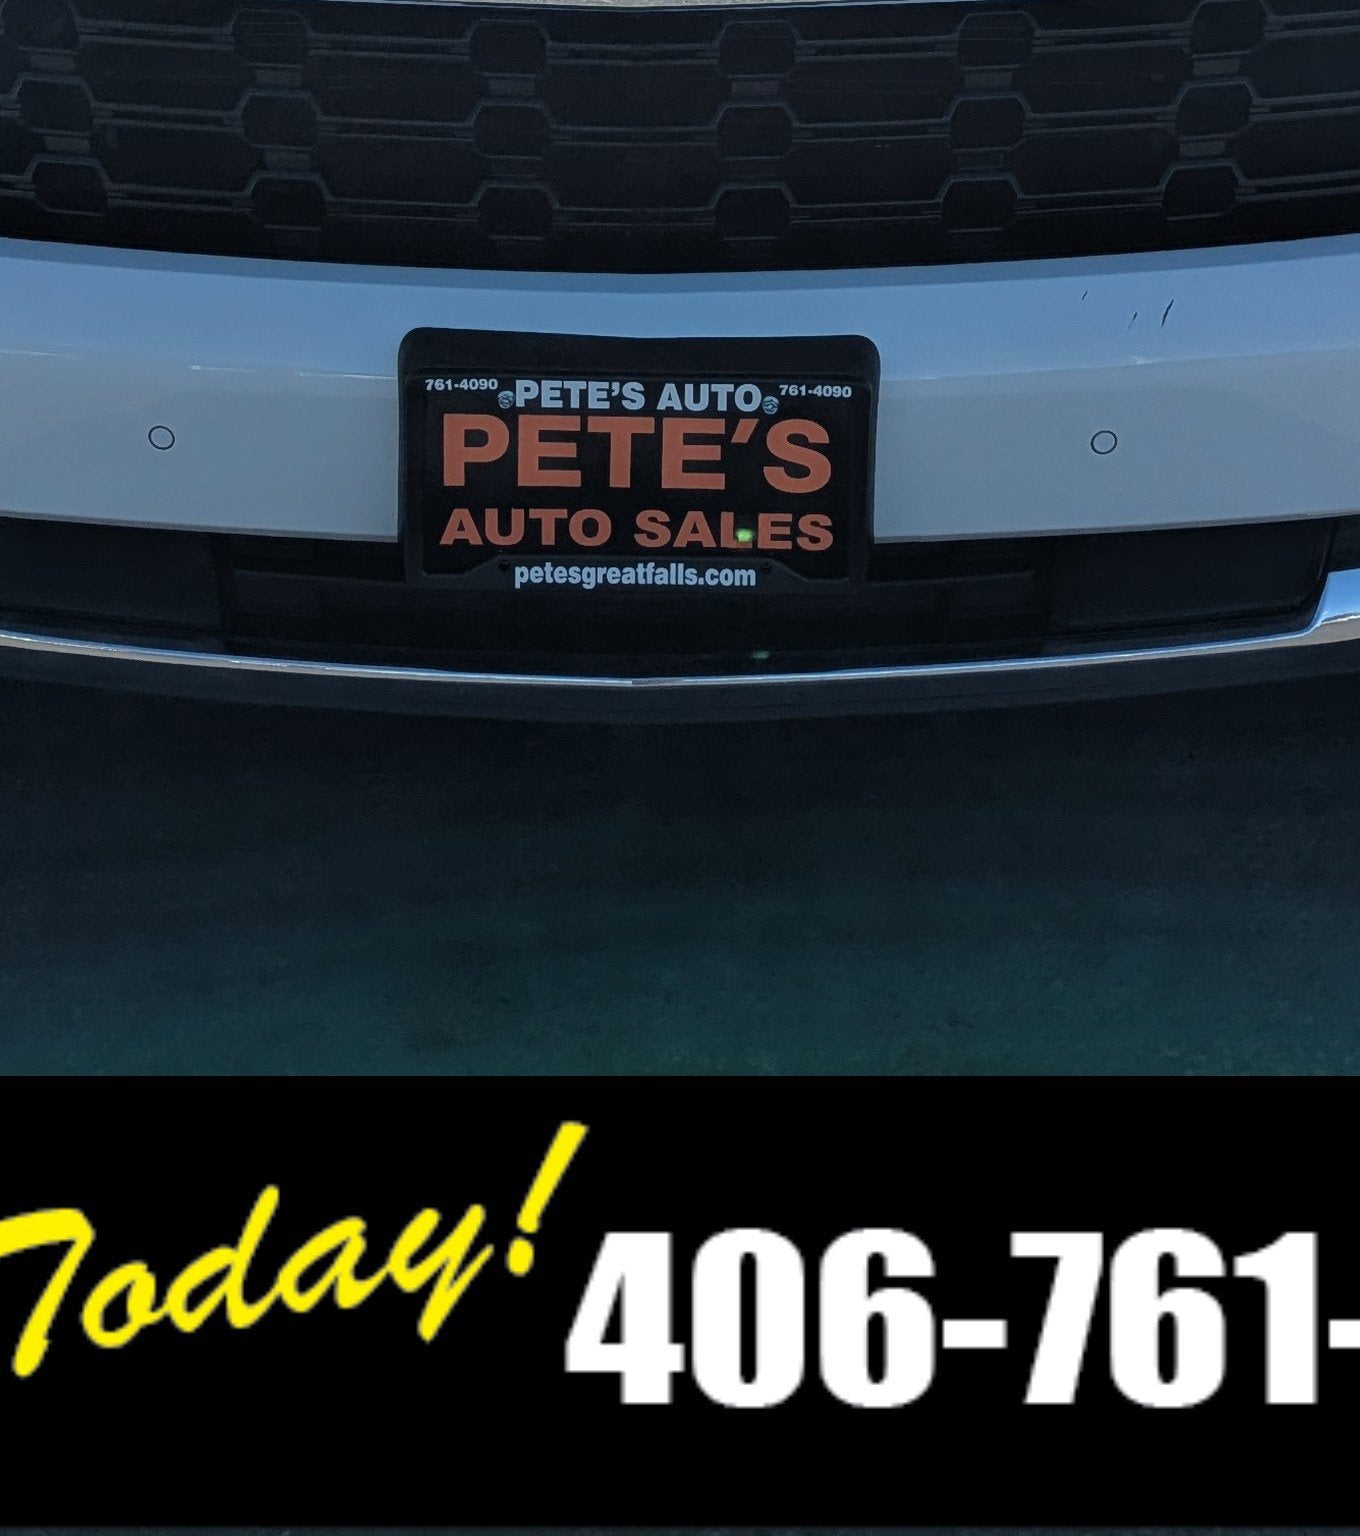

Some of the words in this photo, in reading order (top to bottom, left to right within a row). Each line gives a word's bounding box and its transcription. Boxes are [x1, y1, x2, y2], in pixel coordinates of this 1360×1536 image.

[425, 378, 499, 391] 761-4090
[515, 379, 645, 411] PETE'S
[656, 382, 762, 412] AUTO
[779, 384, 852, 398] 761-4090
[442, 413, 832, 494] PETE'S
[440, 507, 612, 546] AUTO
[634, 509, 834, 551] SALES
[514, 562, 756, 589] petesgreatfalls.com
